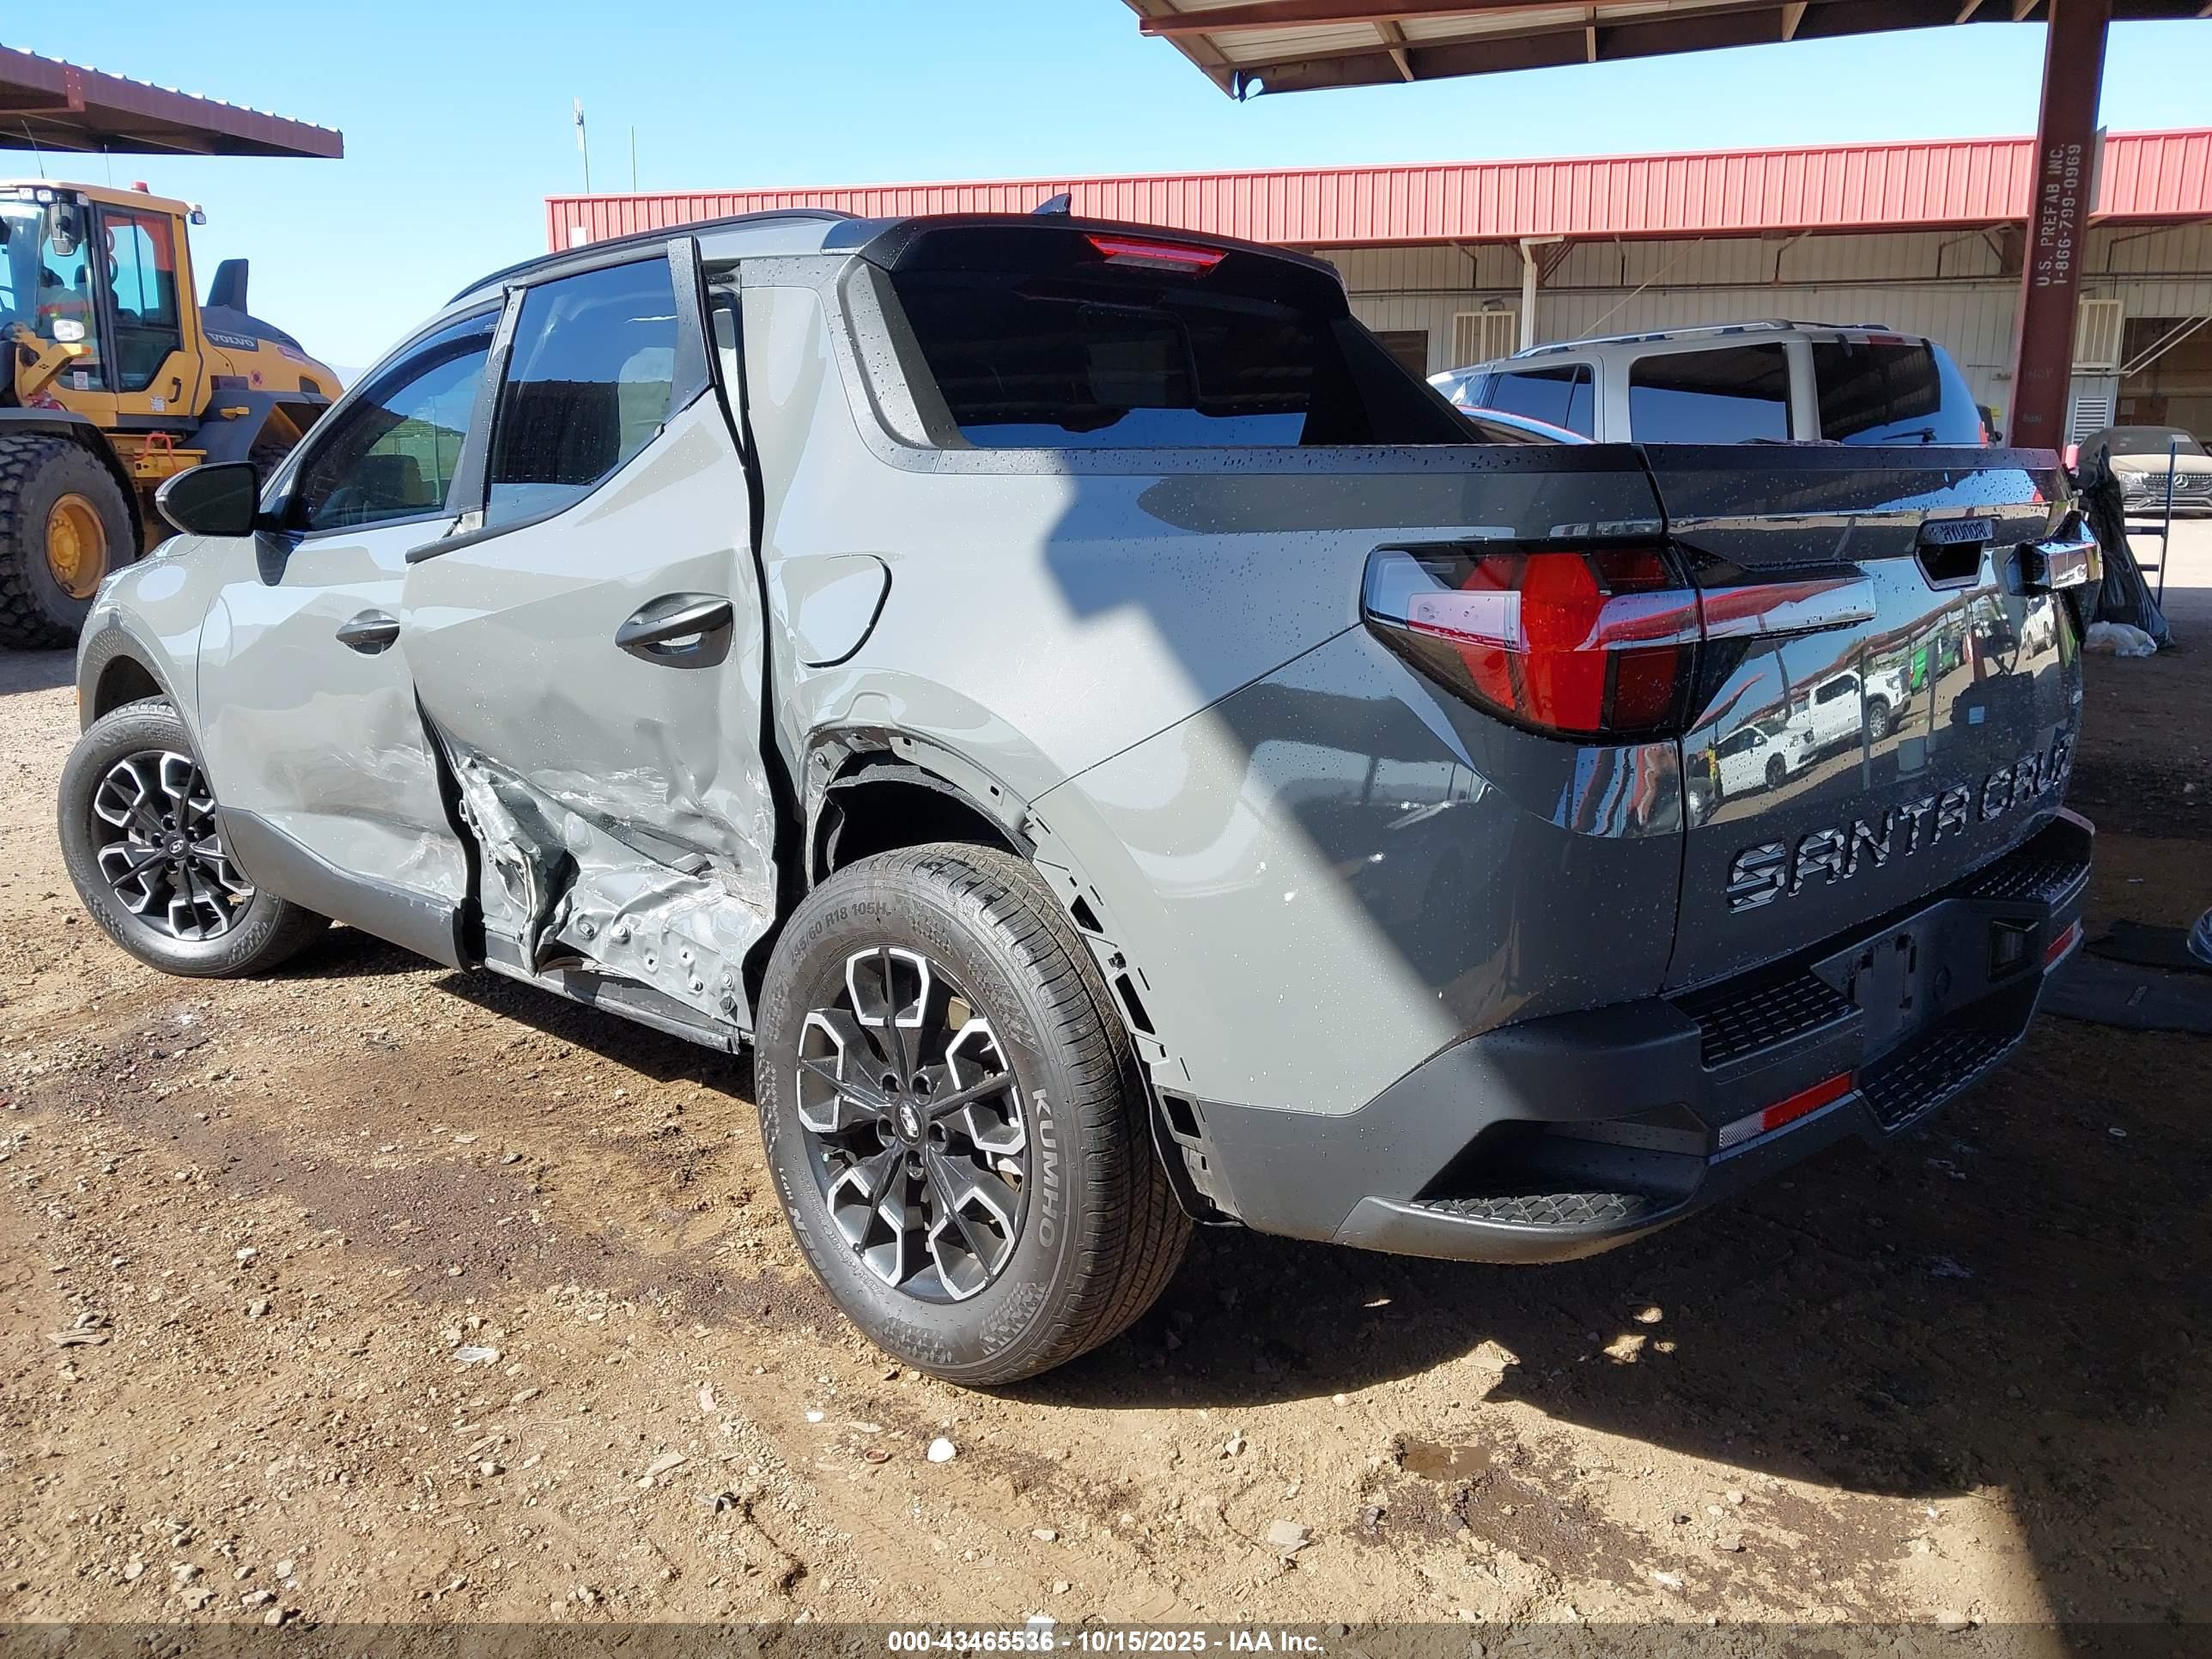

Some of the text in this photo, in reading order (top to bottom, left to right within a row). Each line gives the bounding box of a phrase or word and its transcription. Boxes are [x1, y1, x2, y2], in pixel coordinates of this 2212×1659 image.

[2036, 143, 2064, 286] U.S. PREFAB INC.
[2053, 144, 2081, 284] 1-866-799-0969
[207, 332, 255, 347] VOLVO
[1941, 521, 1989, 541] HYUNDAI
[1726, 733, 2075, 915] SANTA CRUZ
[825, 906, 848, 927] R18
[778, 1167, 794, 1200] HP71
[1032, 1088, 1059, 1248] KUMHO
